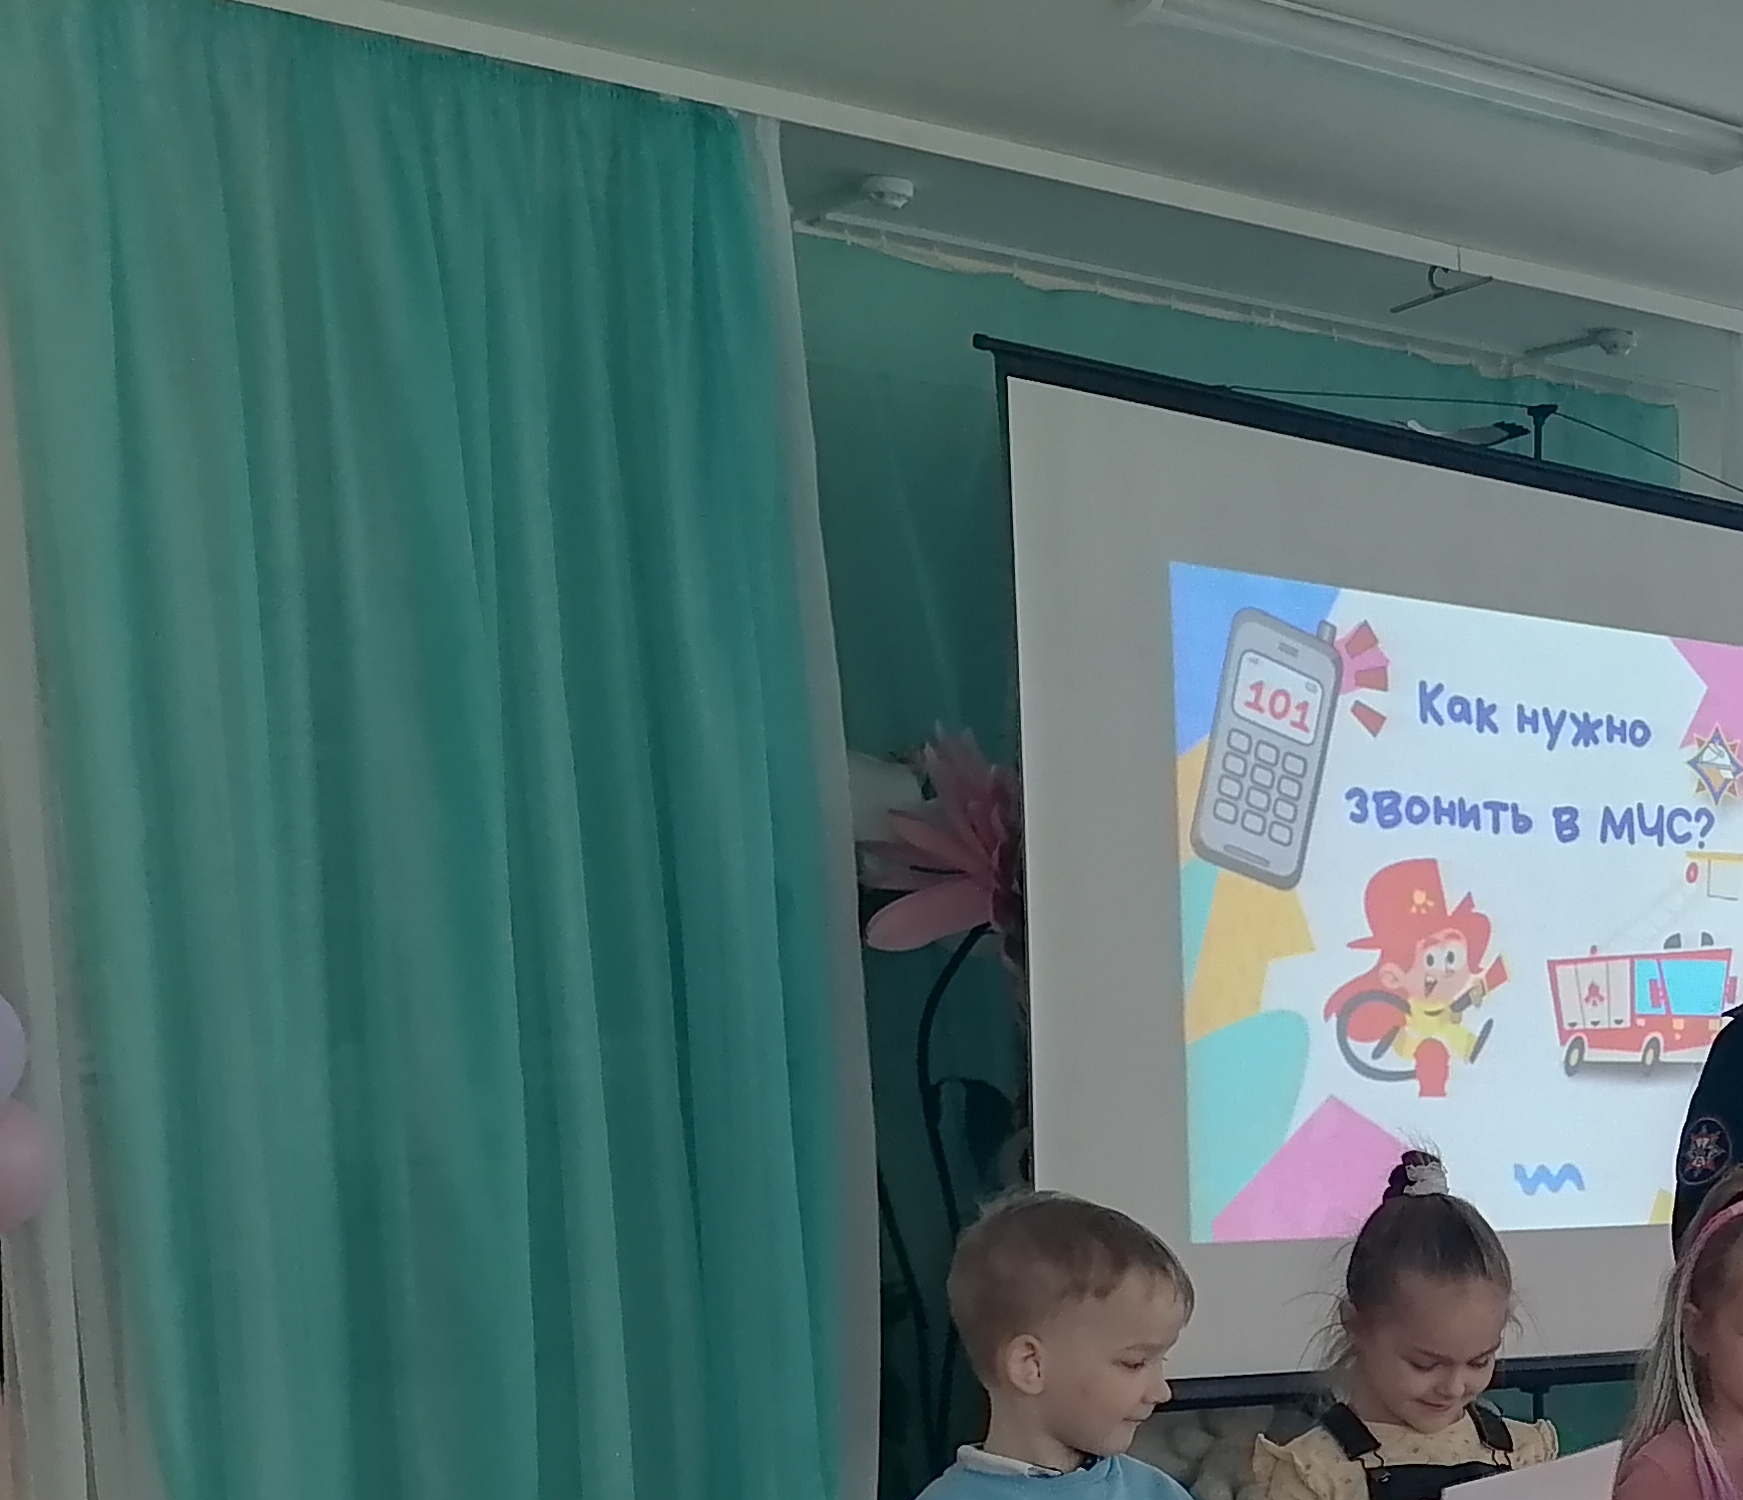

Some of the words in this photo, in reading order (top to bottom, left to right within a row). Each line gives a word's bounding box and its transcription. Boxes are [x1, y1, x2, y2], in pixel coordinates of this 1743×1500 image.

[1243, 680, 1310, 734] 101
[1418, 680, 1499, 734] Как
[1515, 703, 1652, 751] нужно
[1344, 786, 1534, 836] звонить
[1552, 805, 1581, 844] в
[1600, 802, 1716, 850] МЧС?
